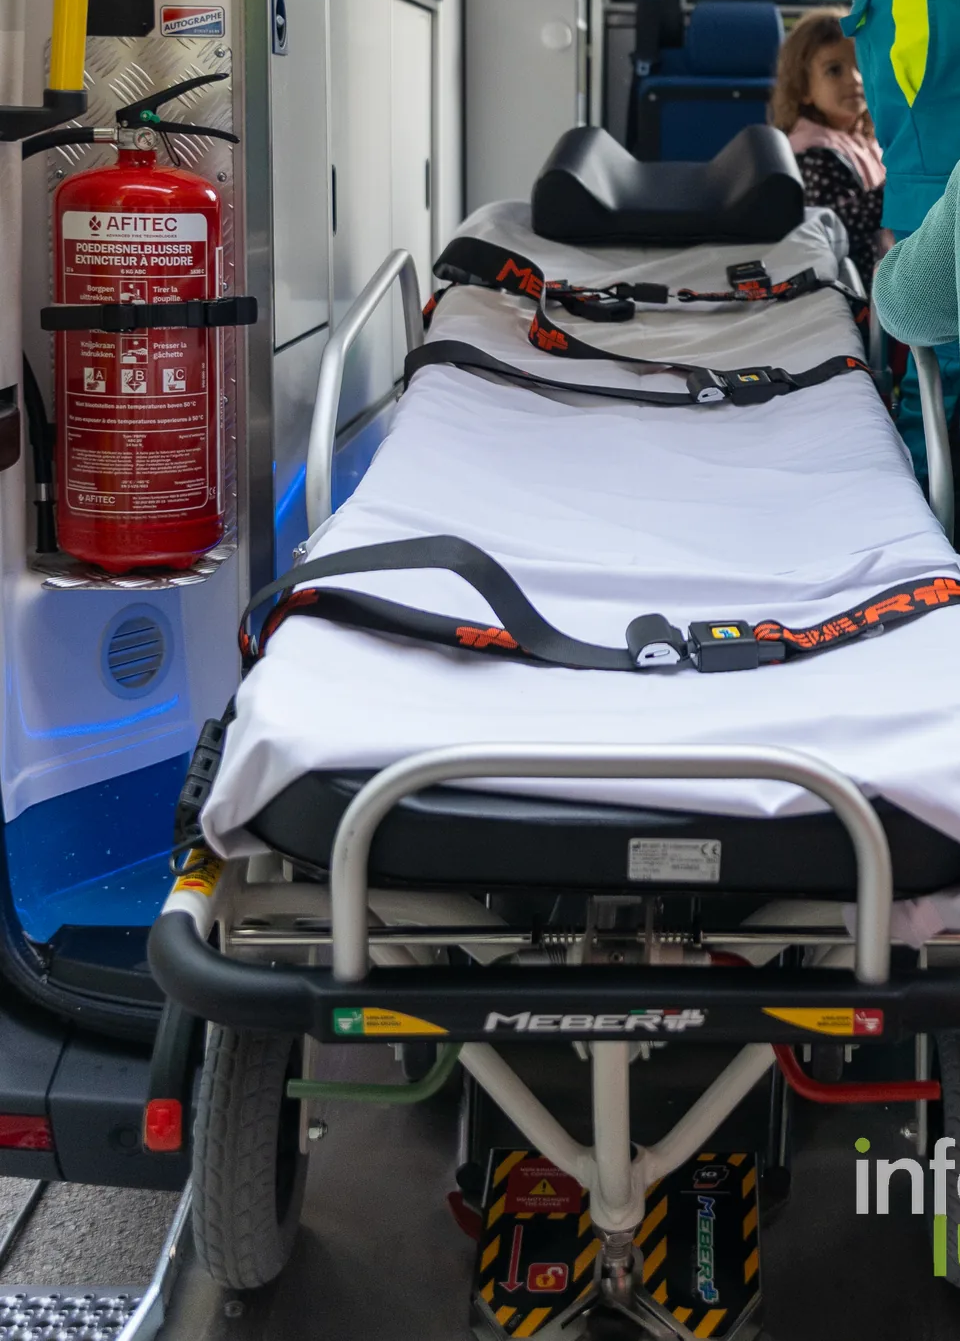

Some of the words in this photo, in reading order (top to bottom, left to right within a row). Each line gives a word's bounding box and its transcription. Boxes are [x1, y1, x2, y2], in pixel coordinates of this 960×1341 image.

[164, 11, 222, 31] AUTOGRAPHE
[106, 215, 178, 232] AFITEC
[76, 242, 192, 255] POEDERSNELBLUSSER
[75, 254, 138, 266] EXTINCTEUR
[139, 254, 149, 267] À
[150, 256, 193, 267] POUDRE
[86, 284, 115, 294] Borgpen
[153, 286, 170, 294] Tirer
[79, 293, 116, 302] uittrekken.
[152, 294, 183, 304] goupille.
[153, 342, 179, 350] Presser
[80, 349, 116, 358] indrukken.
[152, 350, 184, 360] gâchette
[95, 370, 104, 380] A
[135, 370, 145, 381] B
[175, 368, 185, 380] C
[84, 494, 116, 504] AFITEC
[483, 1011, 662, 1033] MEBER
[698, 1195, 716, 1281] MEBER
